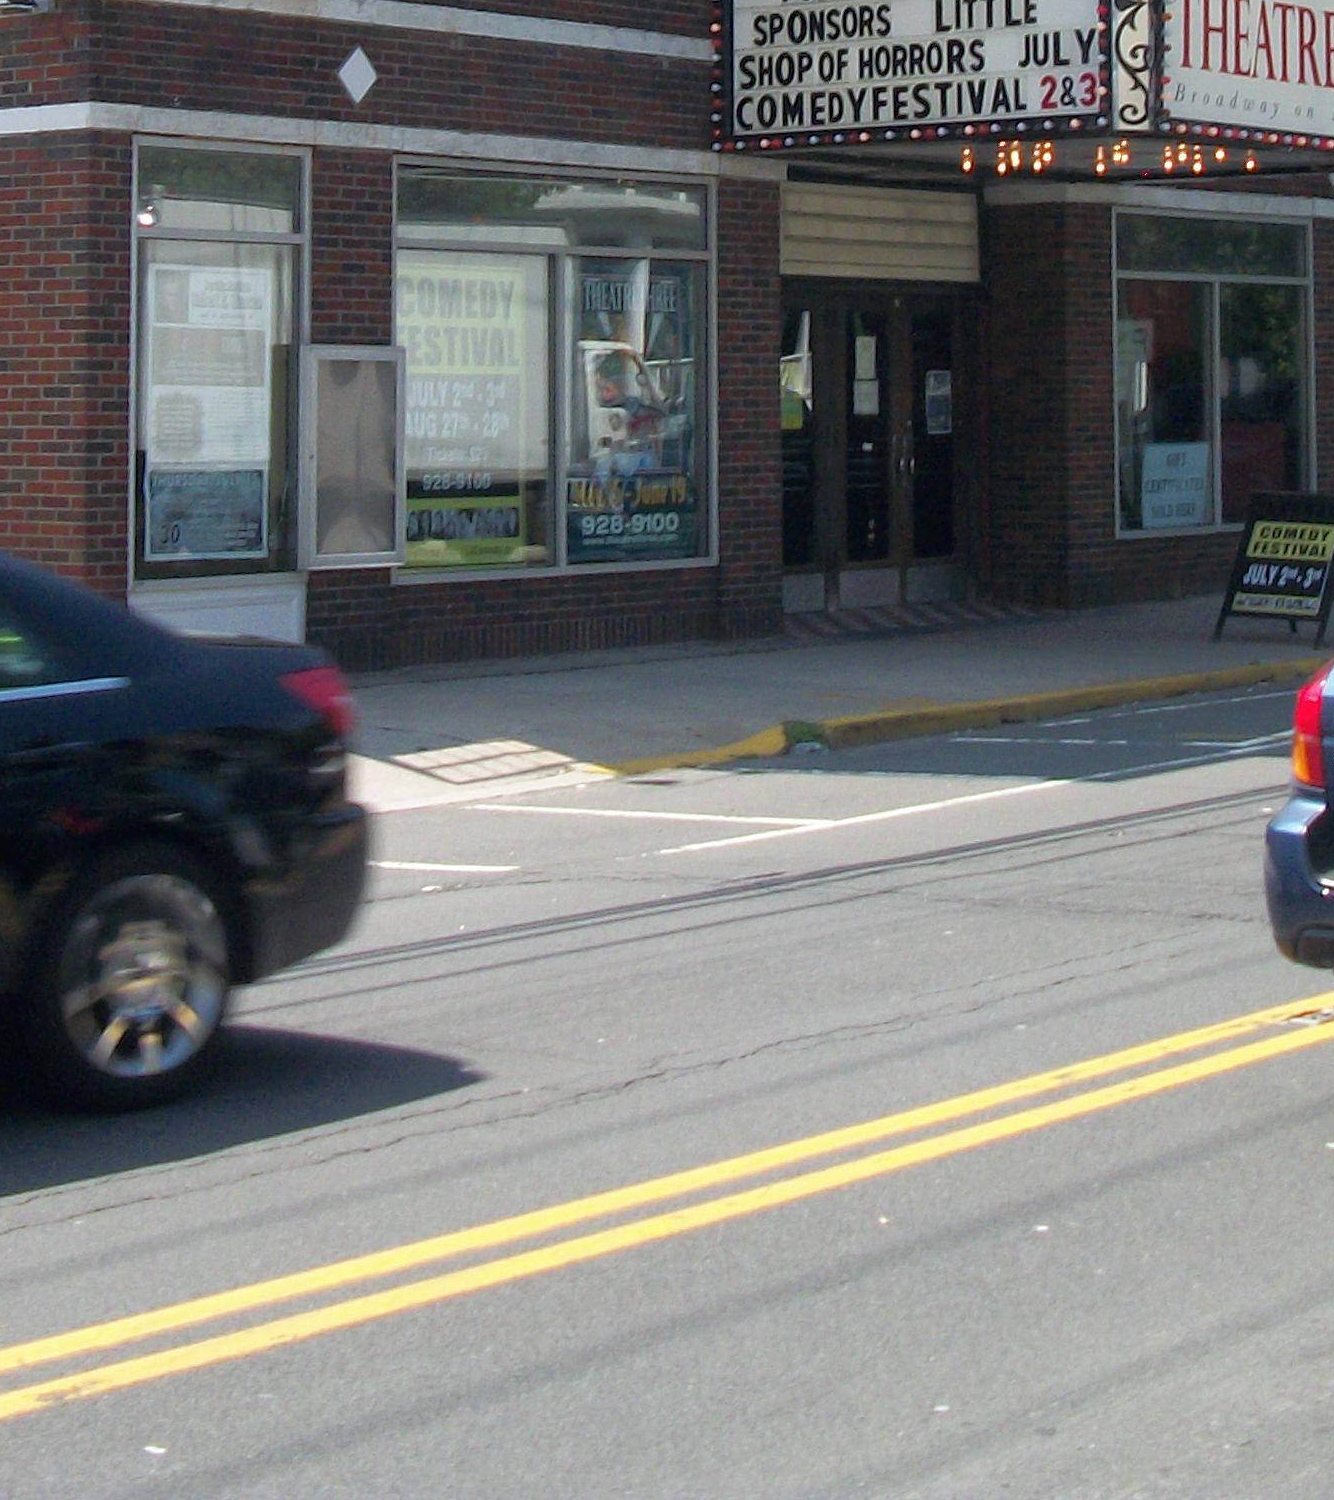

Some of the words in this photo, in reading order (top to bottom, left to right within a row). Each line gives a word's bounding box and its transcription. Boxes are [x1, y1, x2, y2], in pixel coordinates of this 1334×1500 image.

[753, 4, 892, 46] SPONSORS
[739, 51, 813, 90] SHOP
[818, 49, 849, 84] OF
[858, 38, 985, 79] HORRORS
[1018, 27, 1096, 68] JULY
[736, 88, 866, 130] COMEDY
[872, 77, 1027, 120] FESTIVAL
[1174, 83, 1279, 119] Broadway
[1295, 104, 1314, 117] on
[397, 275, 515, 320] COMEDY
[582, 512, 680, 535] 928-9100
[1260, 525, 1329, 541] COMEDY
[1252, 541, 1327, 557] FESTIVAL
[1242, 563, 1280, 587] JULY
